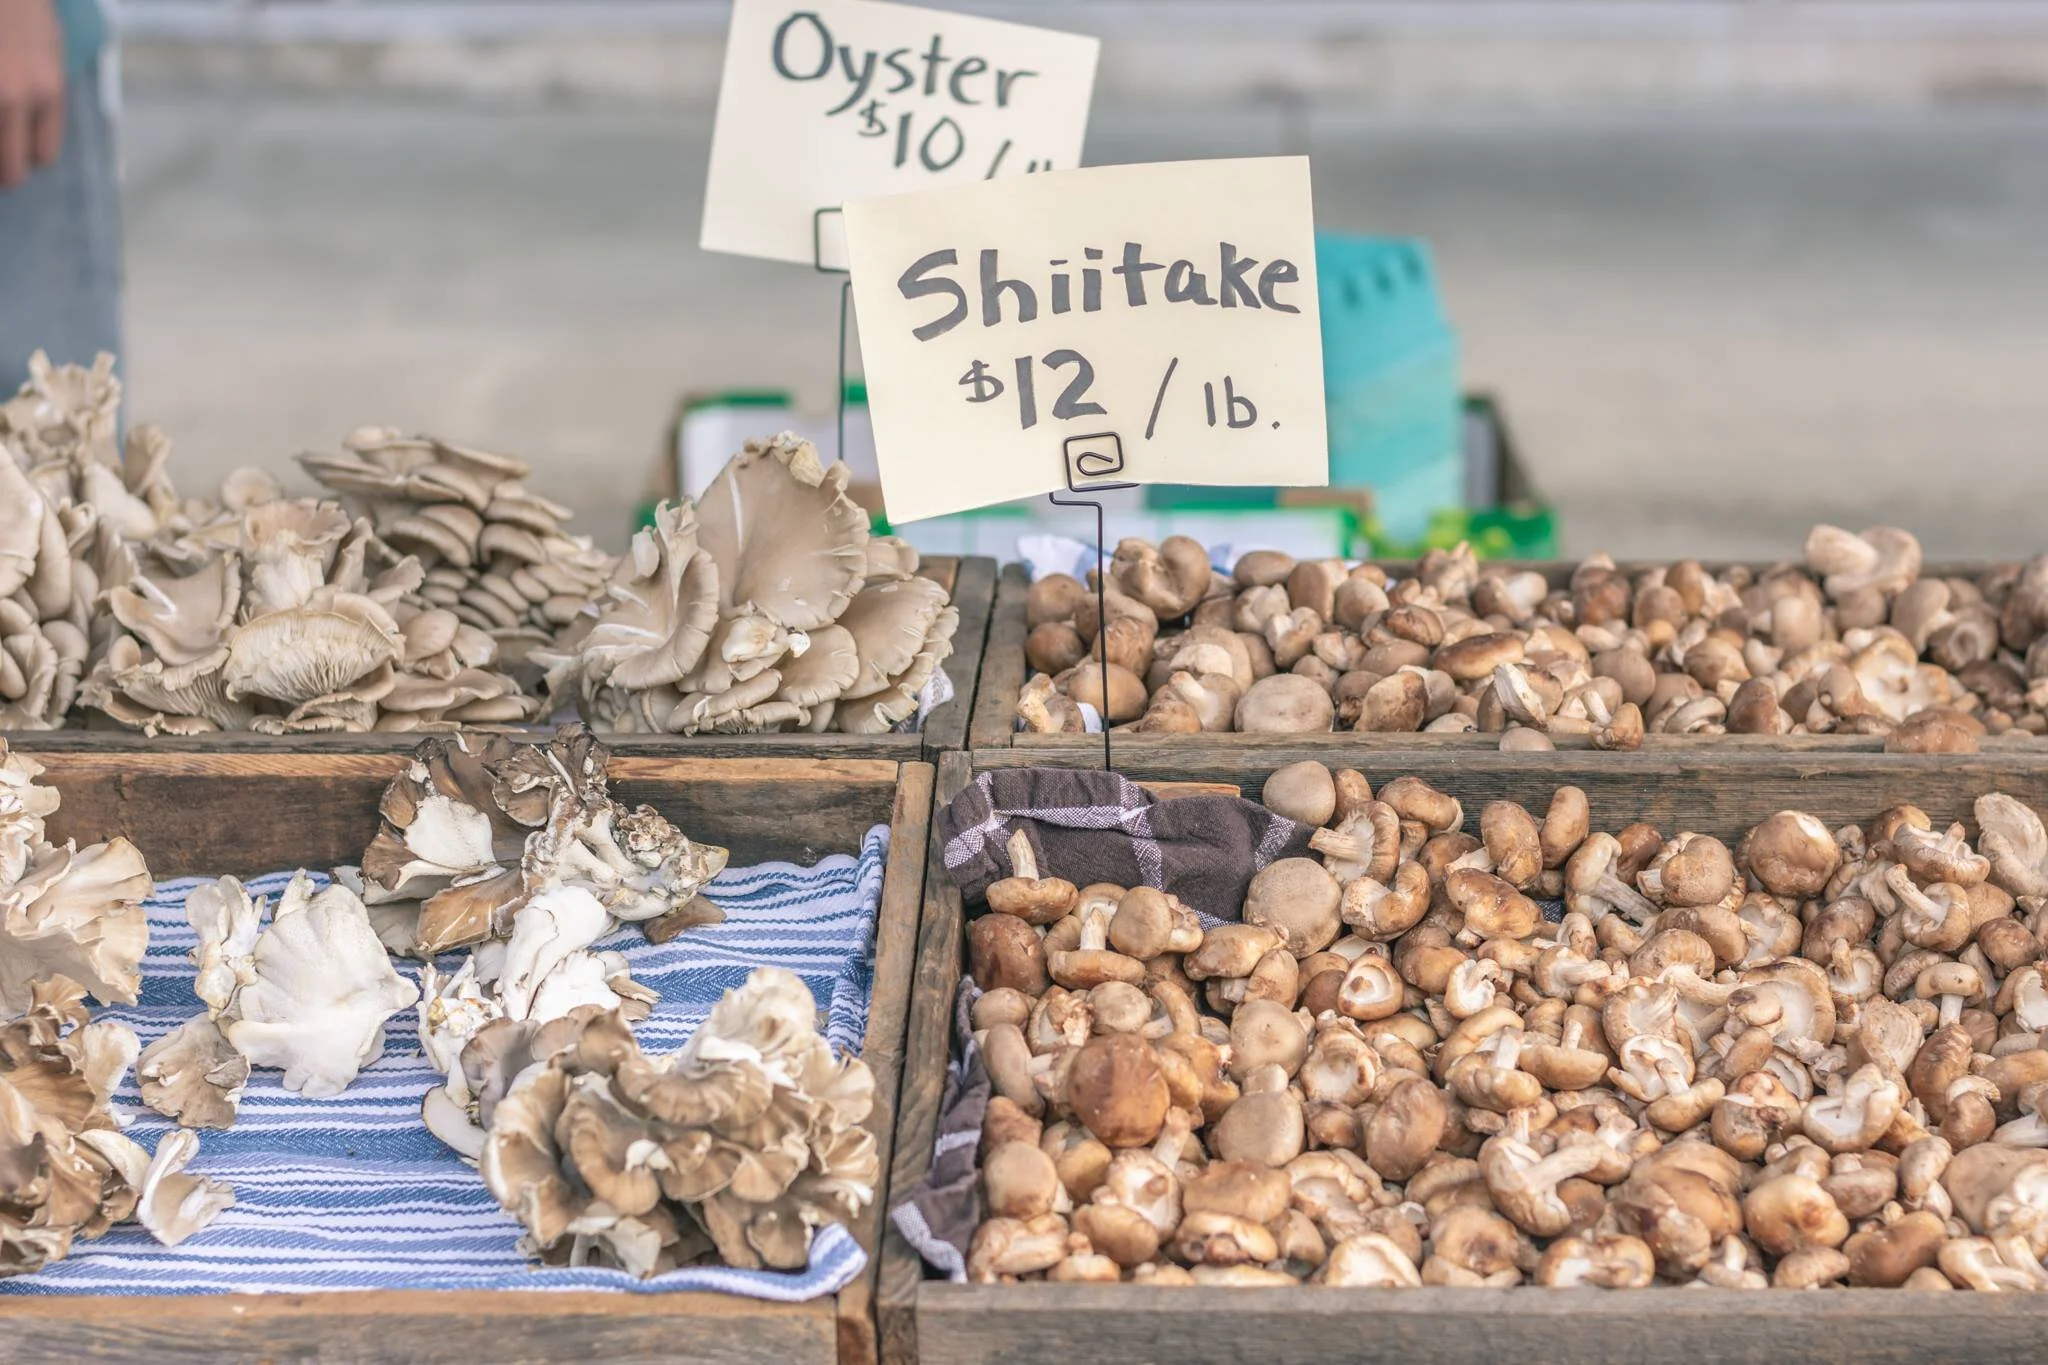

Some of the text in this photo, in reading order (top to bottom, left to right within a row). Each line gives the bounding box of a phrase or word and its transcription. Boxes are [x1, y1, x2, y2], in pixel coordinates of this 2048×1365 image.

[771, 11, 1040, 117] Oyster
[858, 99, 965, 173] $10
[896, 241, 1302, 342] Shiitake
[958, 348, 1108, 430] $12
